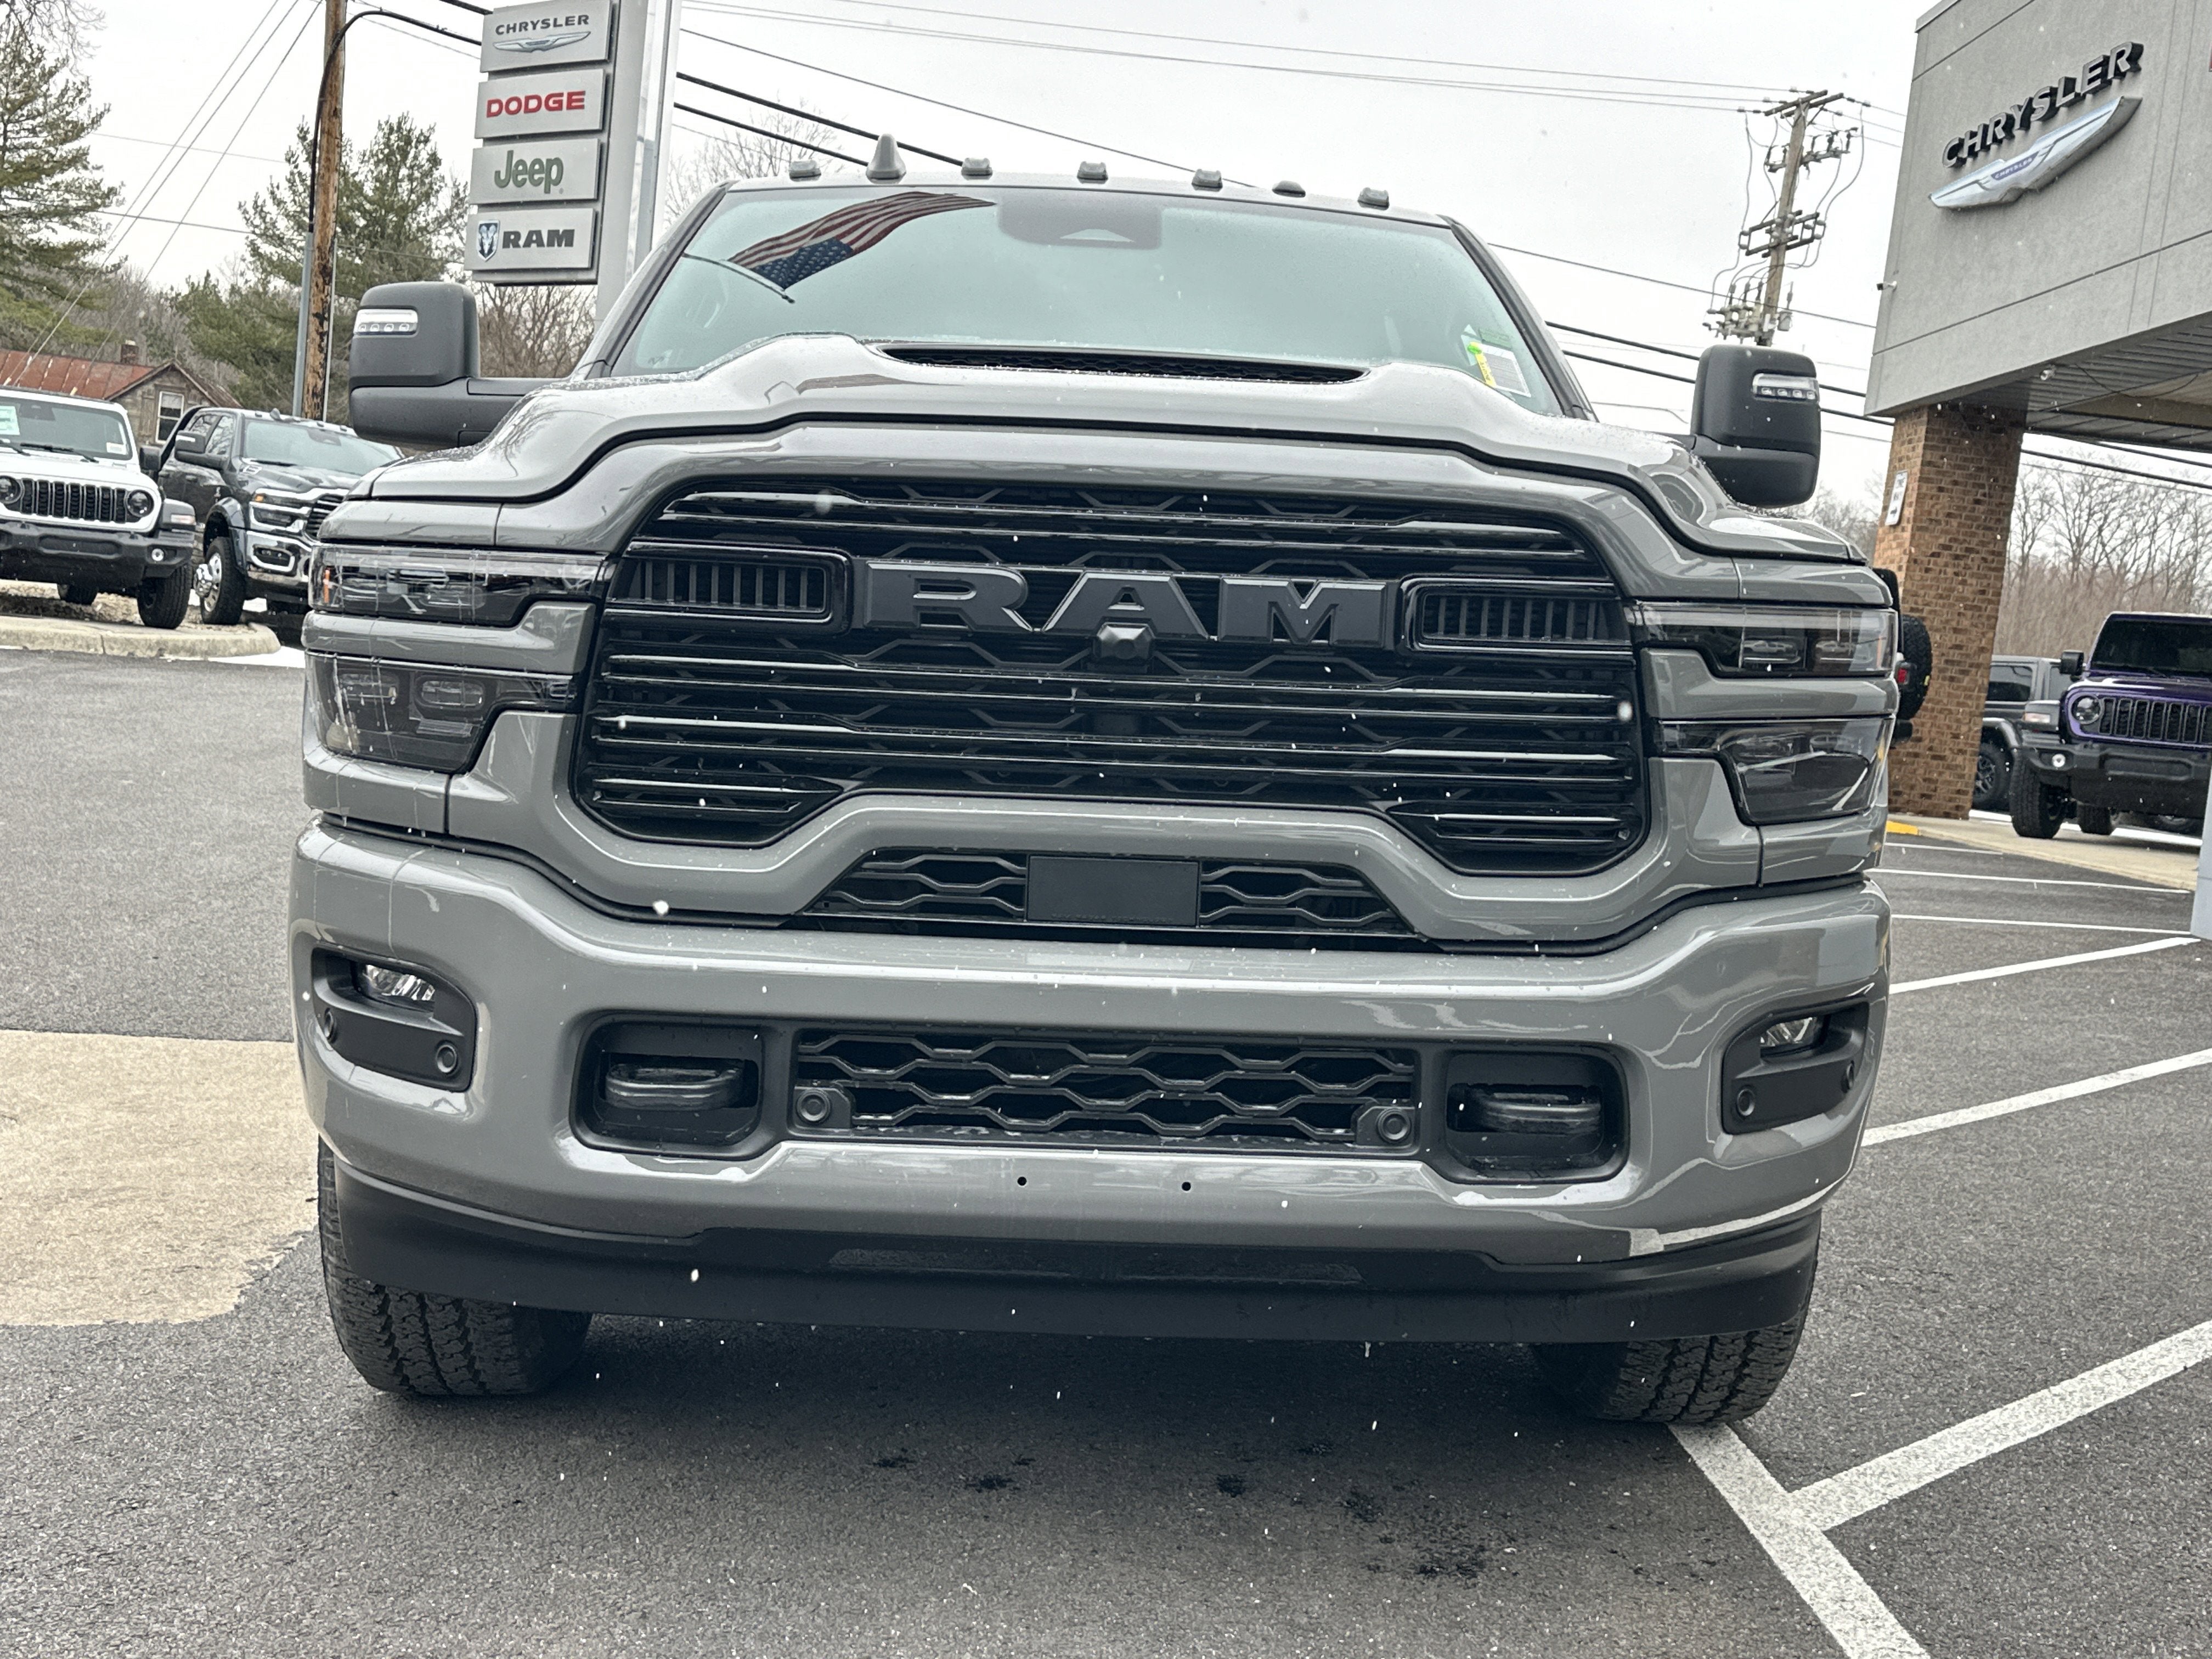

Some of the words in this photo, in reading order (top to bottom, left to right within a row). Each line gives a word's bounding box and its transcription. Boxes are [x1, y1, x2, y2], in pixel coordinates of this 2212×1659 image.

[495, 14, 590, 36] CHRYSLER
[486, 91, 586, 118] DODGE
[1942, 41, 2144, 168] CHRYSLER
[494, 150, 564, 194] Jeep
[502, 229, 575, 250] RAM
[864, 560, 1387, 648] RAM
